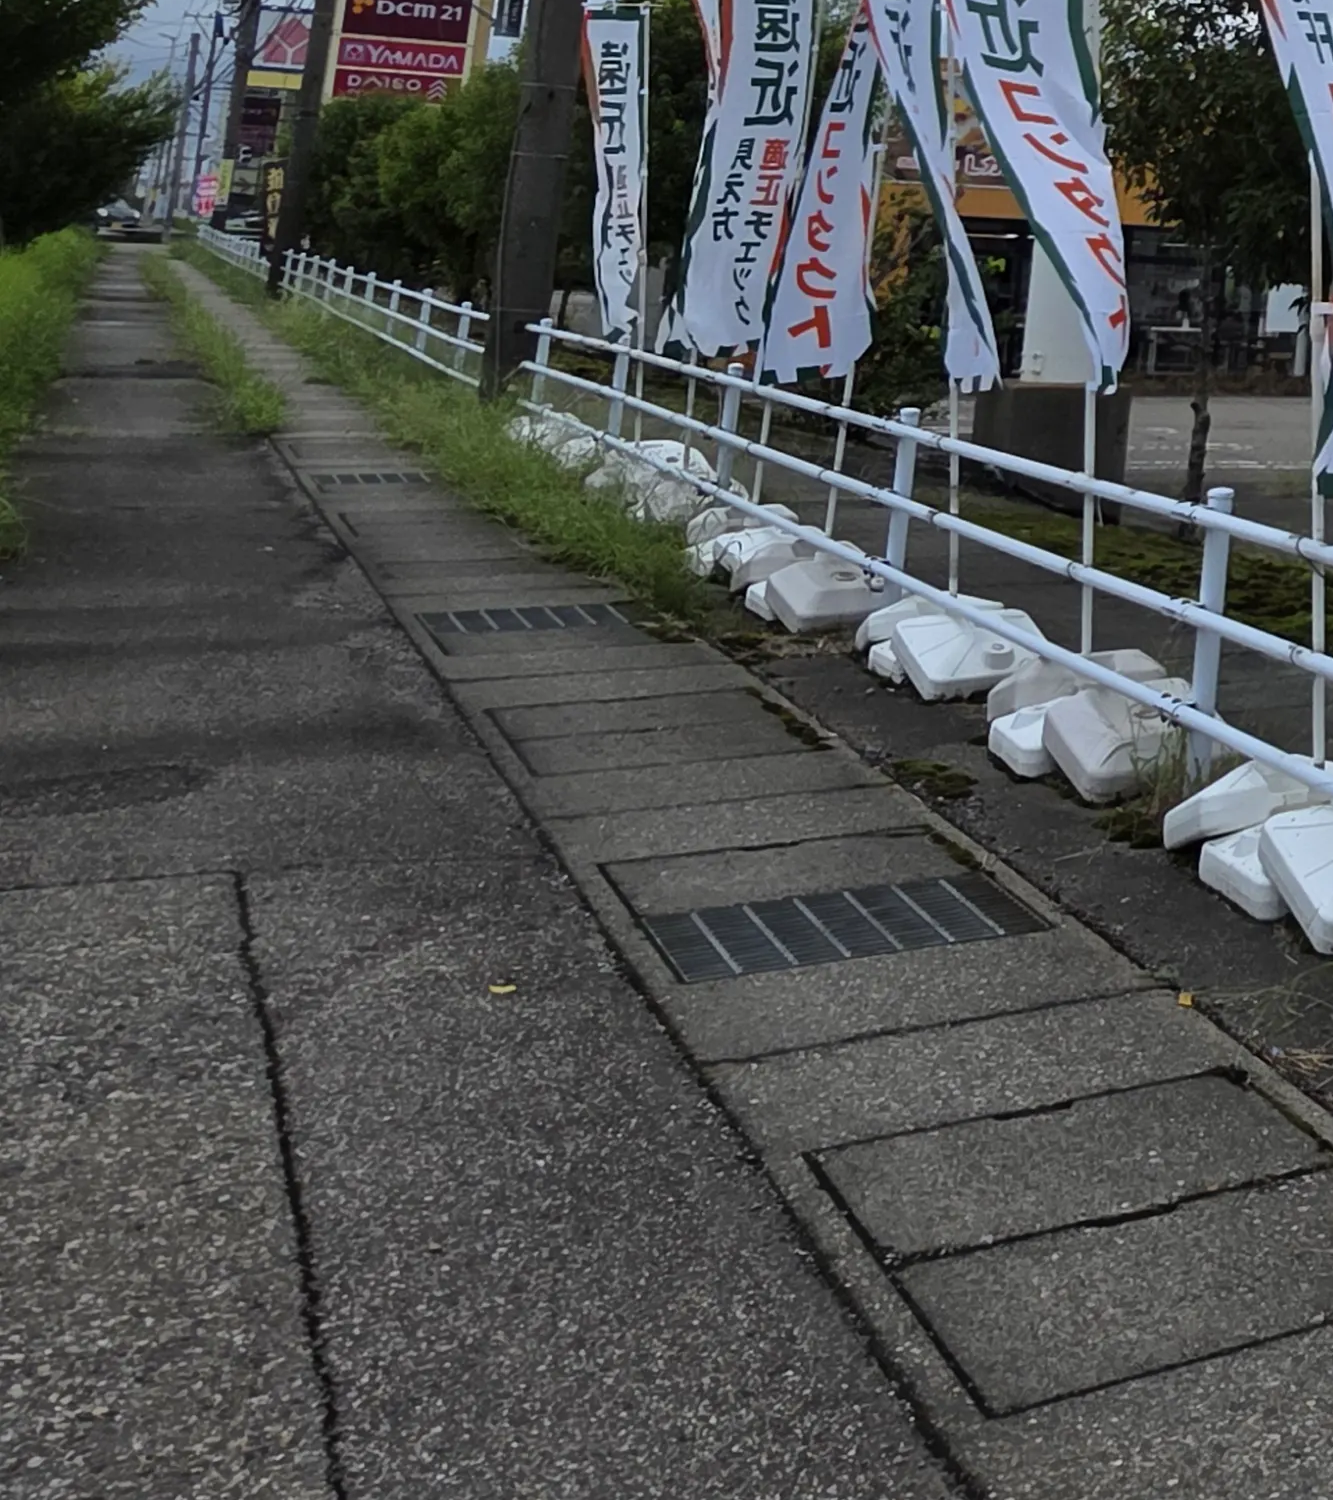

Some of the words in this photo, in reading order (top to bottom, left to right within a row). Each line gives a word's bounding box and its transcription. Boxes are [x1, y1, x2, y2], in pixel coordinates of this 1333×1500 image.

[440, 4, 463, 21] 21
[367, 45, 460, 70] YAMADA
[347, 75, 422, 91] DAISO
